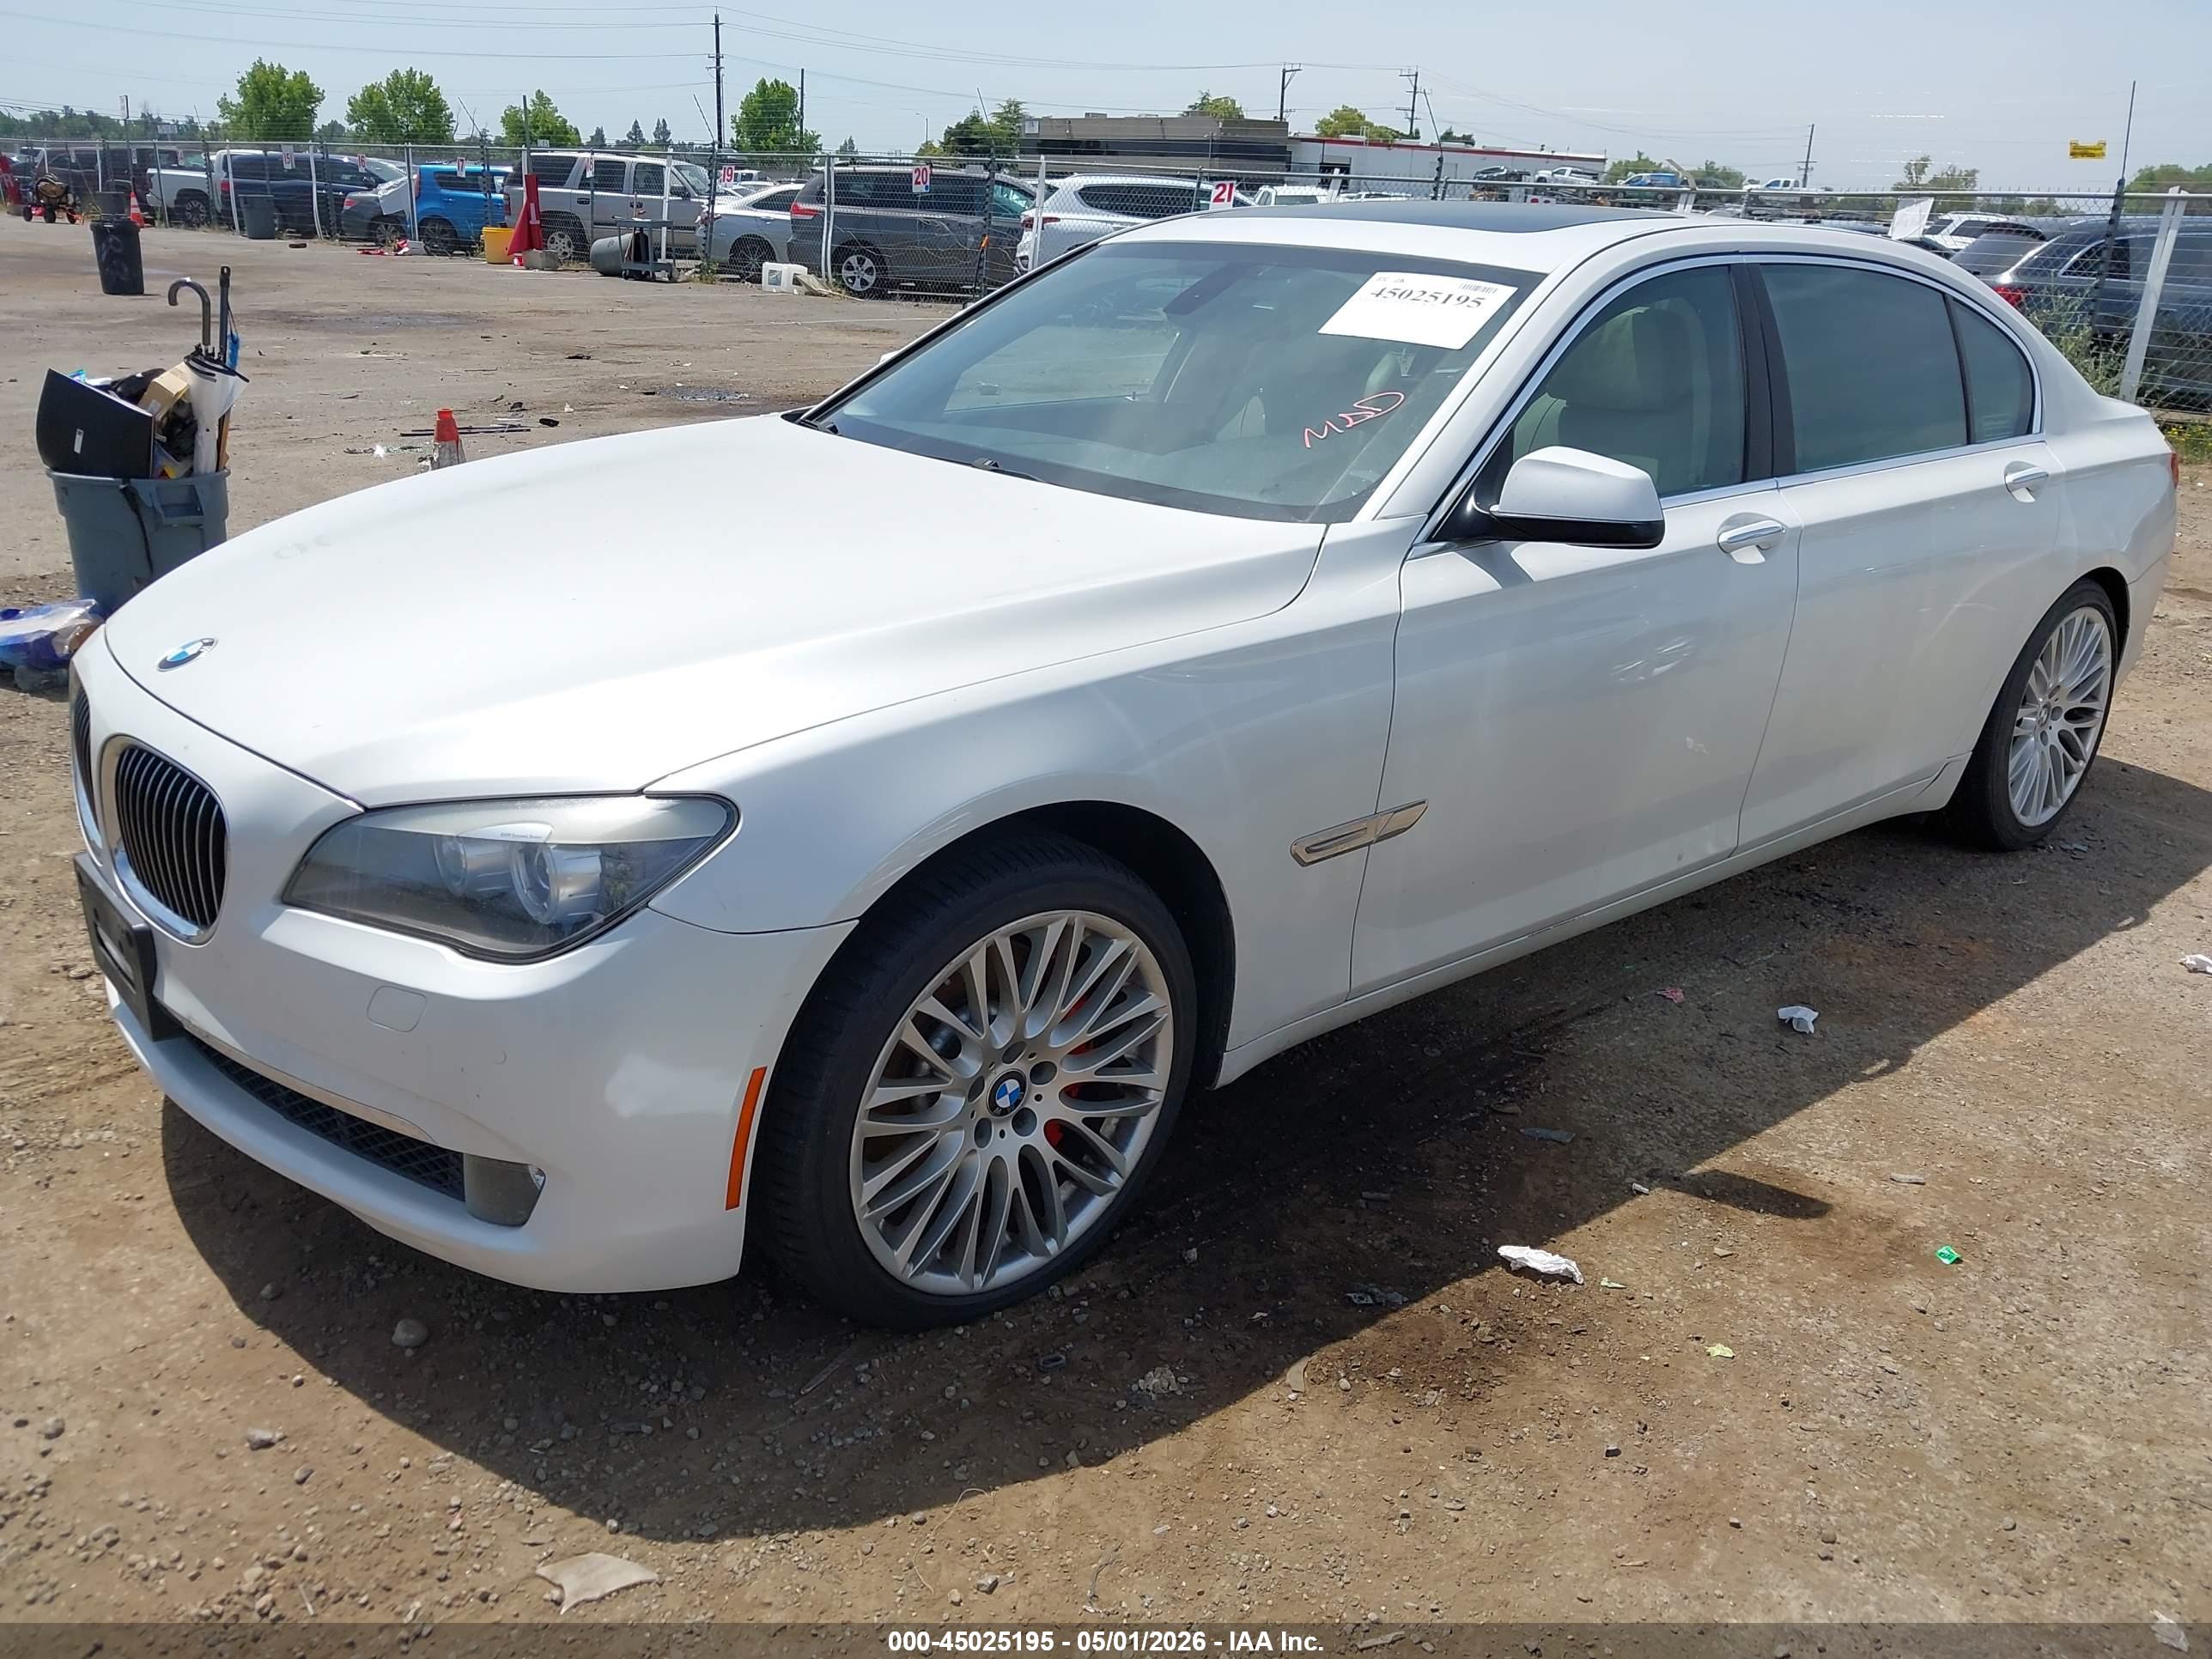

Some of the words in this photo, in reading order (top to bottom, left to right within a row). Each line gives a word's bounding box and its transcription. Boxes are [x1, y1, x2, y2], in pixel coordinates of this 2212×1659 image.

[358, 155, 366, 167] 16
[722, 167, 733, 183] 19
[914, 167, 928, 185] 20
[1212, 182, 1235, 204] 21
[1370, 287, 1486, 308] 45025195
